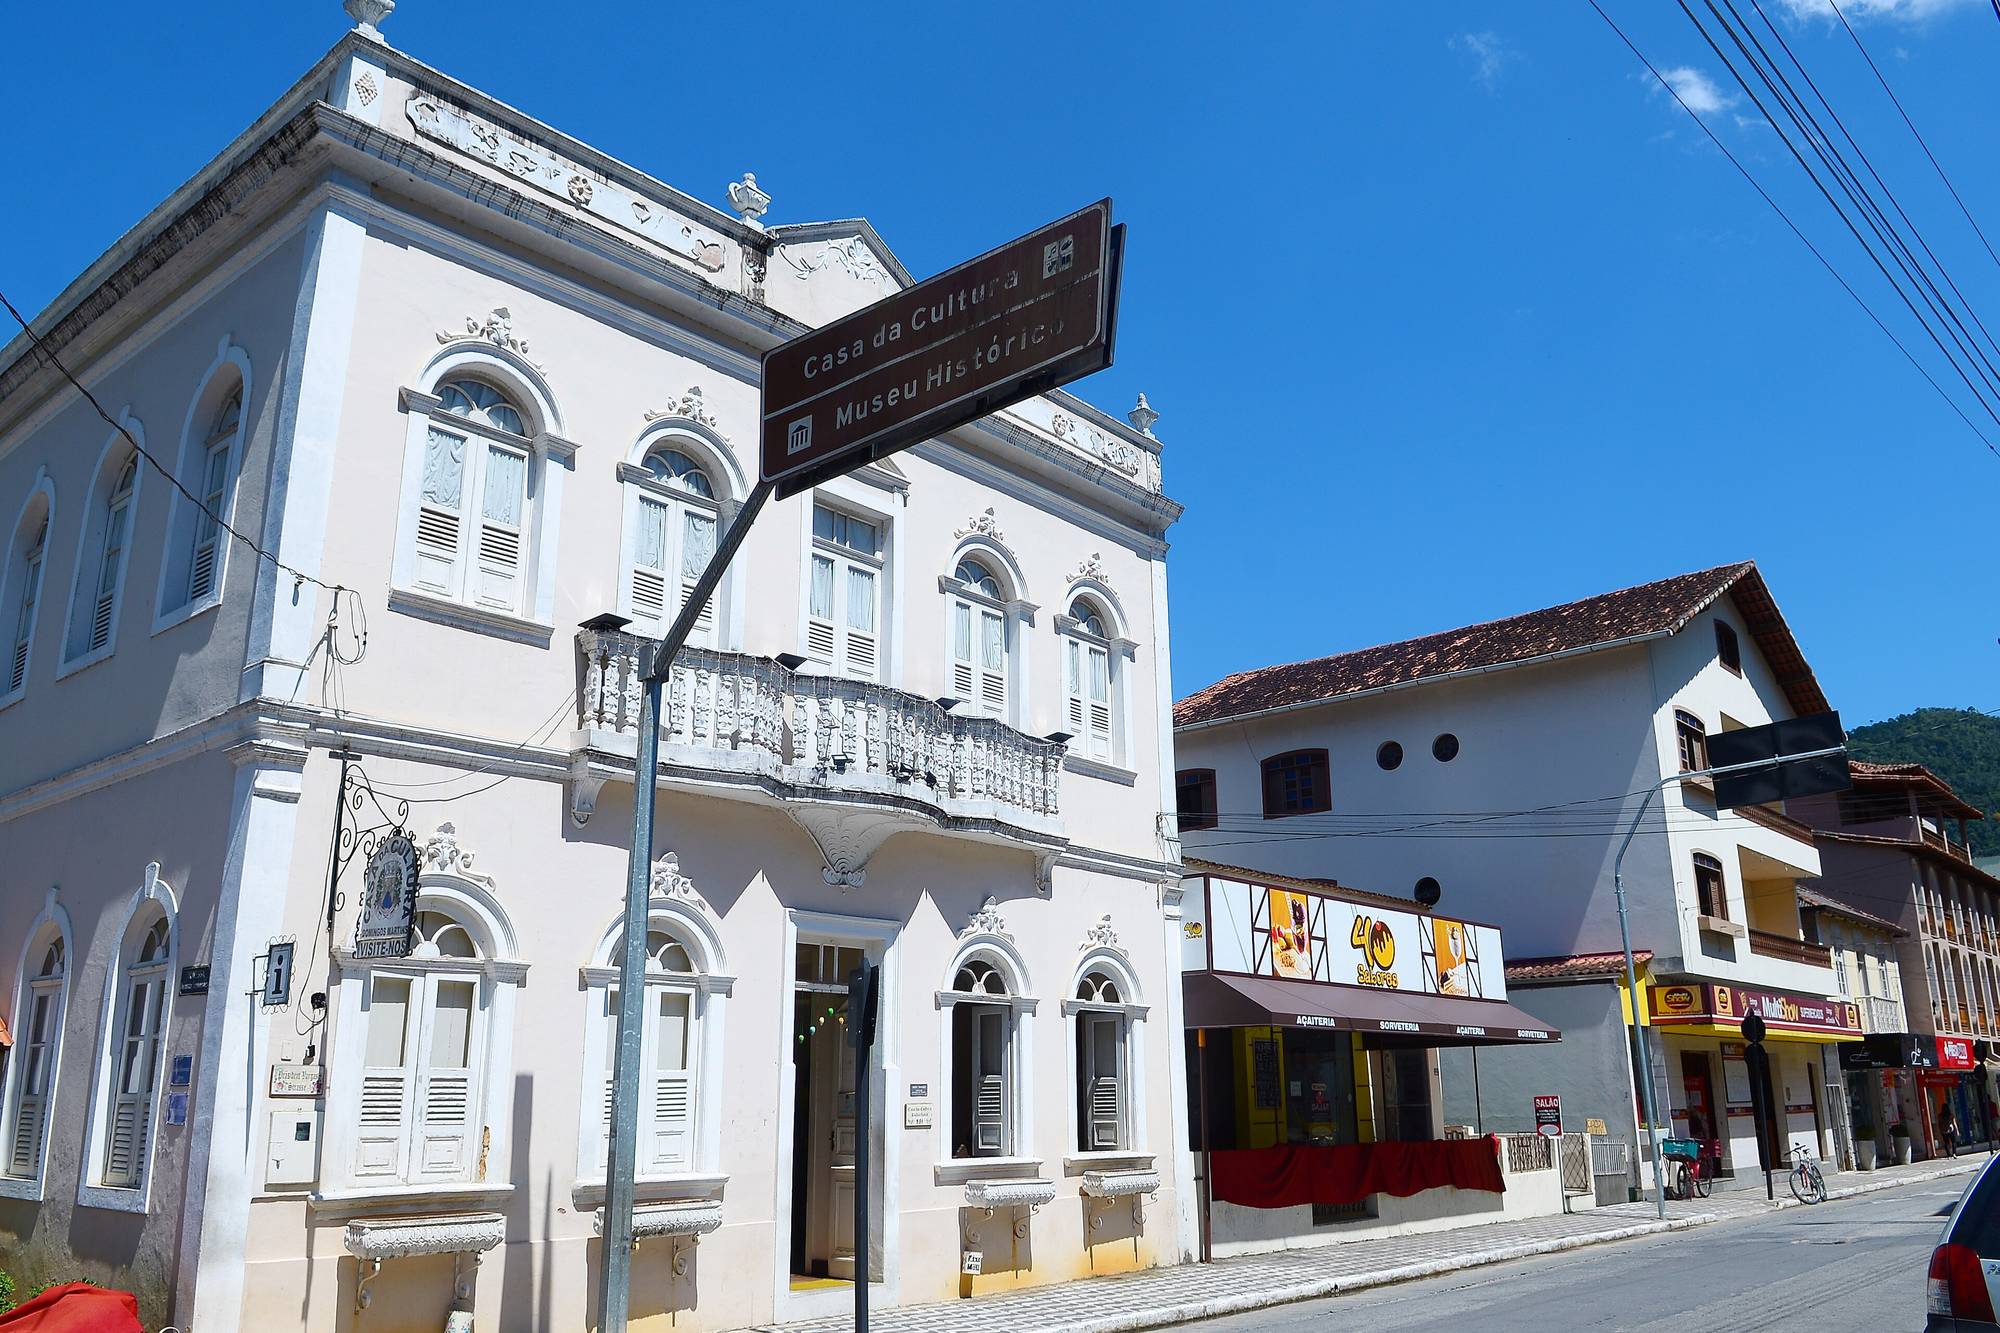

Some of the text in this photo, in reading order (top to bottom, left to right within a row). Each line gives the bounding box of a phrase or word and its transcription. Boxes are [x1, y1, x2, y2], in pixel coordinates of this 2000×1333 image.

[804, 339, 864, 378] Casa
[873, 323, 901, 348] da
[836, 379, 917, 430] Museu
[363, 866, 379, 924] CASA
[391, 839, 416, 920] CULTURA
[361, 940, 407, 957] VISITE-NOS
[1351, 915, 1395, 971] 40
[1357, 963, 1398, 988] Sabores
[1296, 1015, 1336, 1027] AÇAITERIA
[1379, 1021, 1420, 1032] SORVETERIA
[1456, 1026, 1486, 1036] AÇAITERIA
[1517, 1030, 1549, 1039] SORVETERIA
